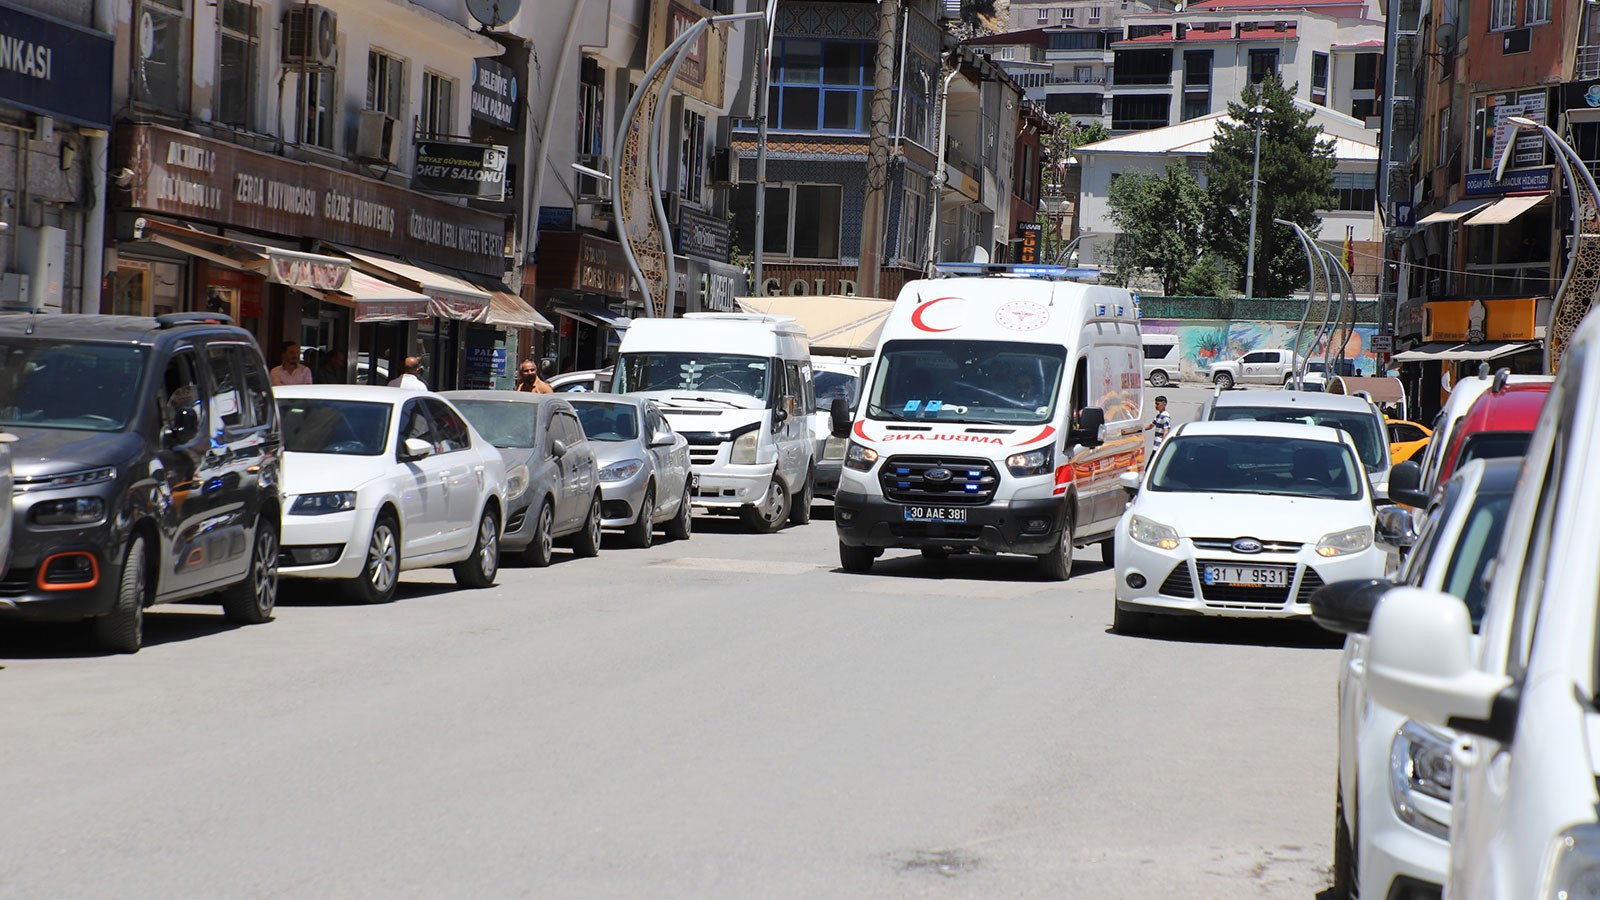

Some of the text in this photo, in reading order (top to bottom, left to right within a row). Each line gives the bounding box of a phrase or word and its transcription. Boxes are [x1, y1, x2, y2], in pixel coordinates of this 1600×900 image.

[472, 91, 512, 124] HALK PAZARI
[418, 156, 481, 167] BEYAZ GÜVERCİN
[416, 164, 503, 183] OKEY SALONU
[237, 173, 316, 217] ZERDA KUYUMCUSU
[325, 189, 350, 223] GÖZDE
[474, 348, 499, 357] PALA
[911, 507, 965, 520] 30 AAE 381
[1213, 568, 1283, 583] 31 Y 9531
